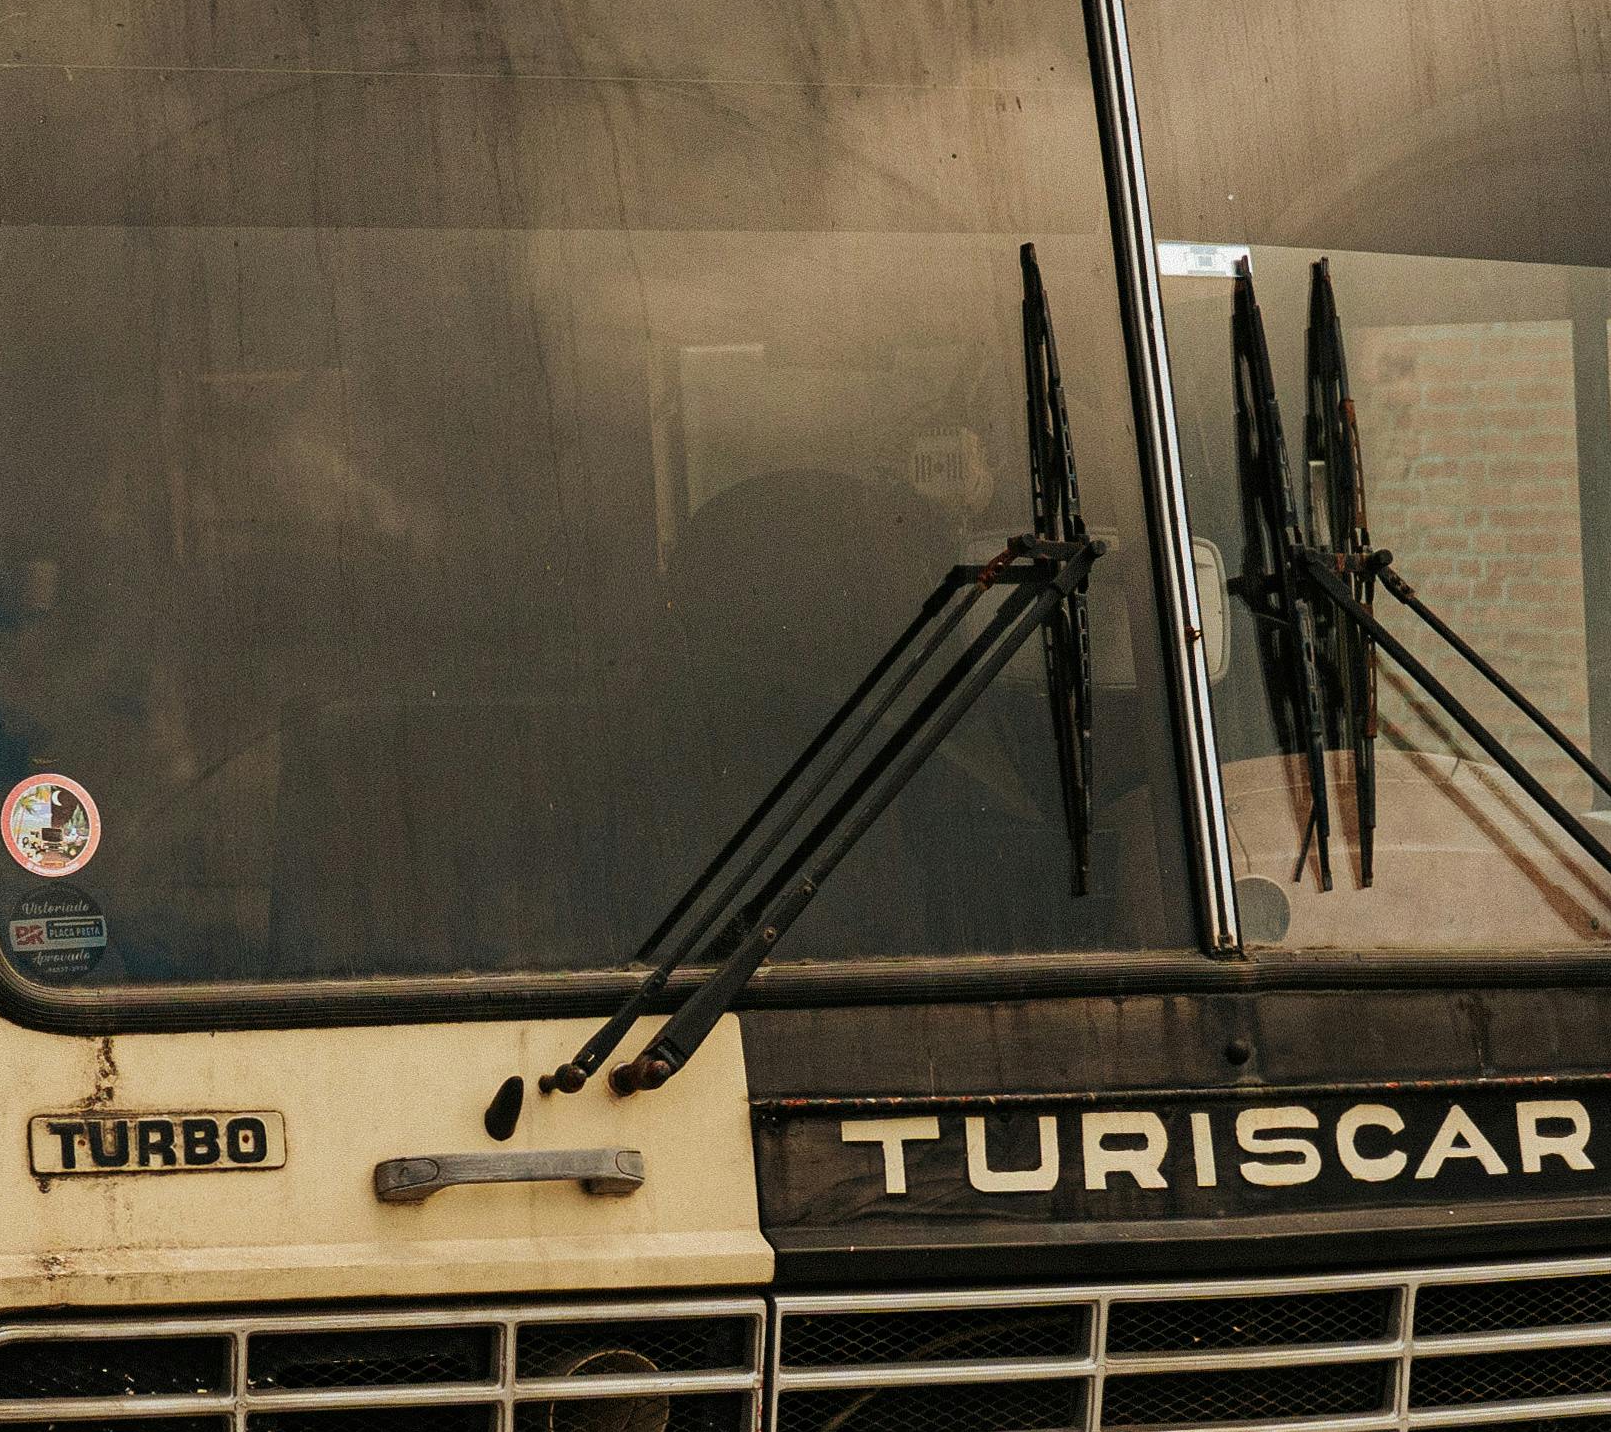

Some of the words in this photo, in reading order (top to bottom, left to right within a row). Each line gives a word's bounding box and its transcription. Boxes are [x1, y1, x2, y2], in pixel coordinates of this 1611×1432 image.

[22, 899, 90, 915] Vistoriado
[48, 928, 74, 938] PLACA
[75, 926, 100, 937] PRETA
[33, 950, 90, 965] Aprovado
[47, 1117, 267, 1169] TURBO
[841, 1100, 1595, 1194] TURISCAR
